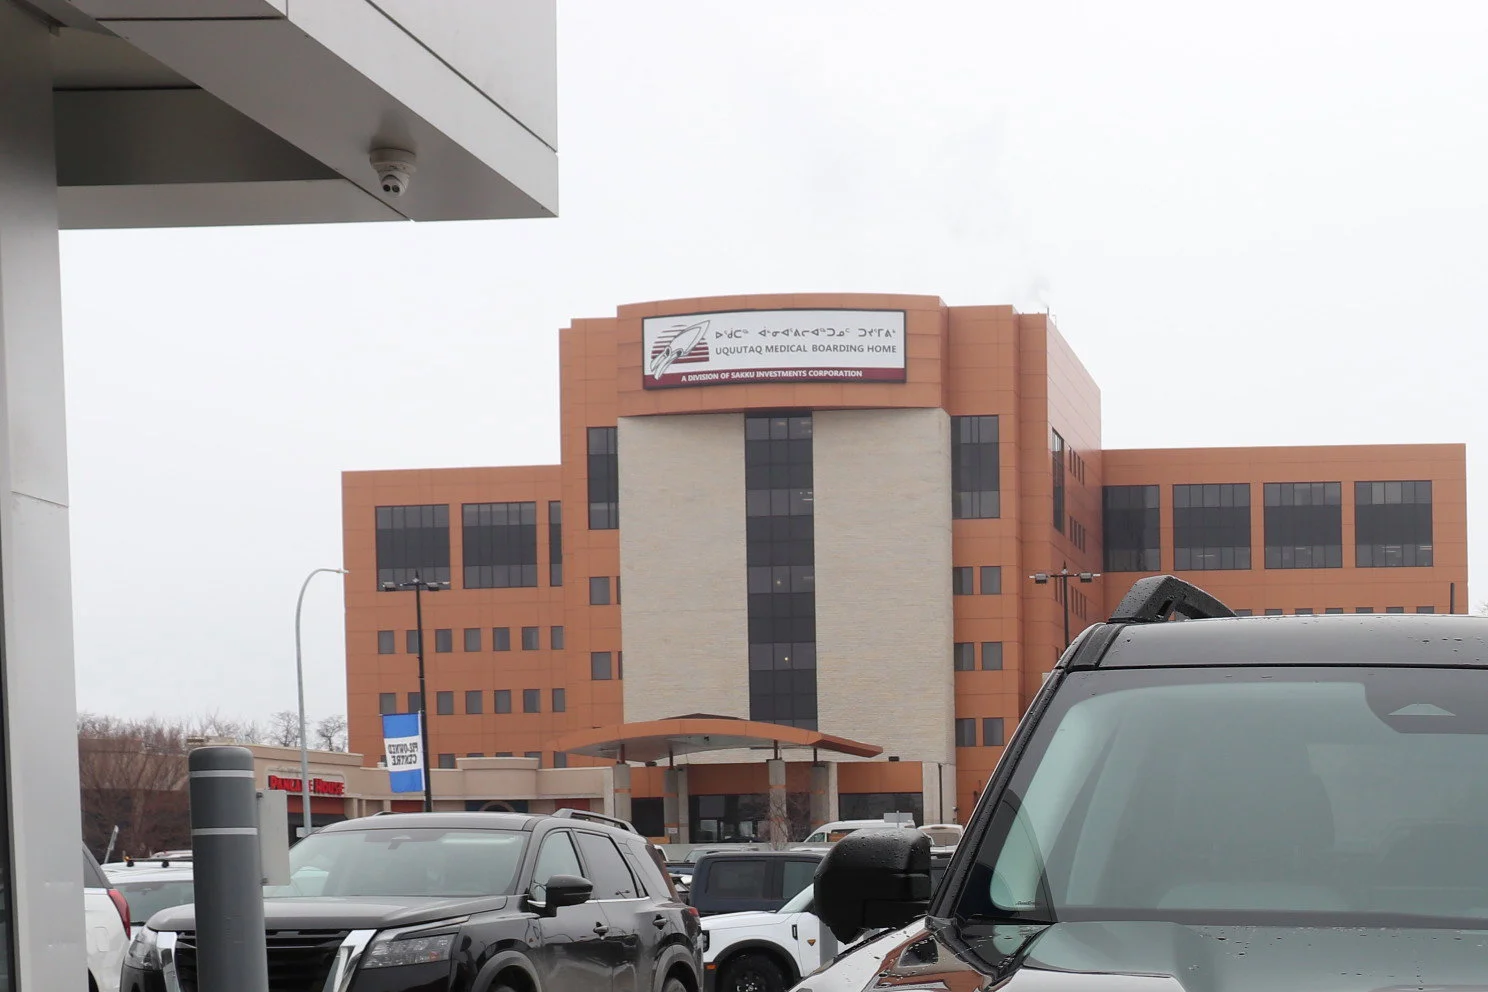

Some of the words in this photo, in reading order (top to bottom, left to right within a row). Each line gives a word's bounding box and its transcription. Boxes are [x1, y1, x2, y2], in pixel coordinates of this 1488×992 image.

[715, 345, 763, 356] UQUUTAQ
[765, 344, 808, 354] MEDICAL
[812, 344, 864, 353] BOARDING
[867, 345, 897, 353] HOME
[688, 372, 719, 382] DIVISION
[731, 371, 755, 379] SAKKU
[756, 370, 807, 378] INVESTMENTS
